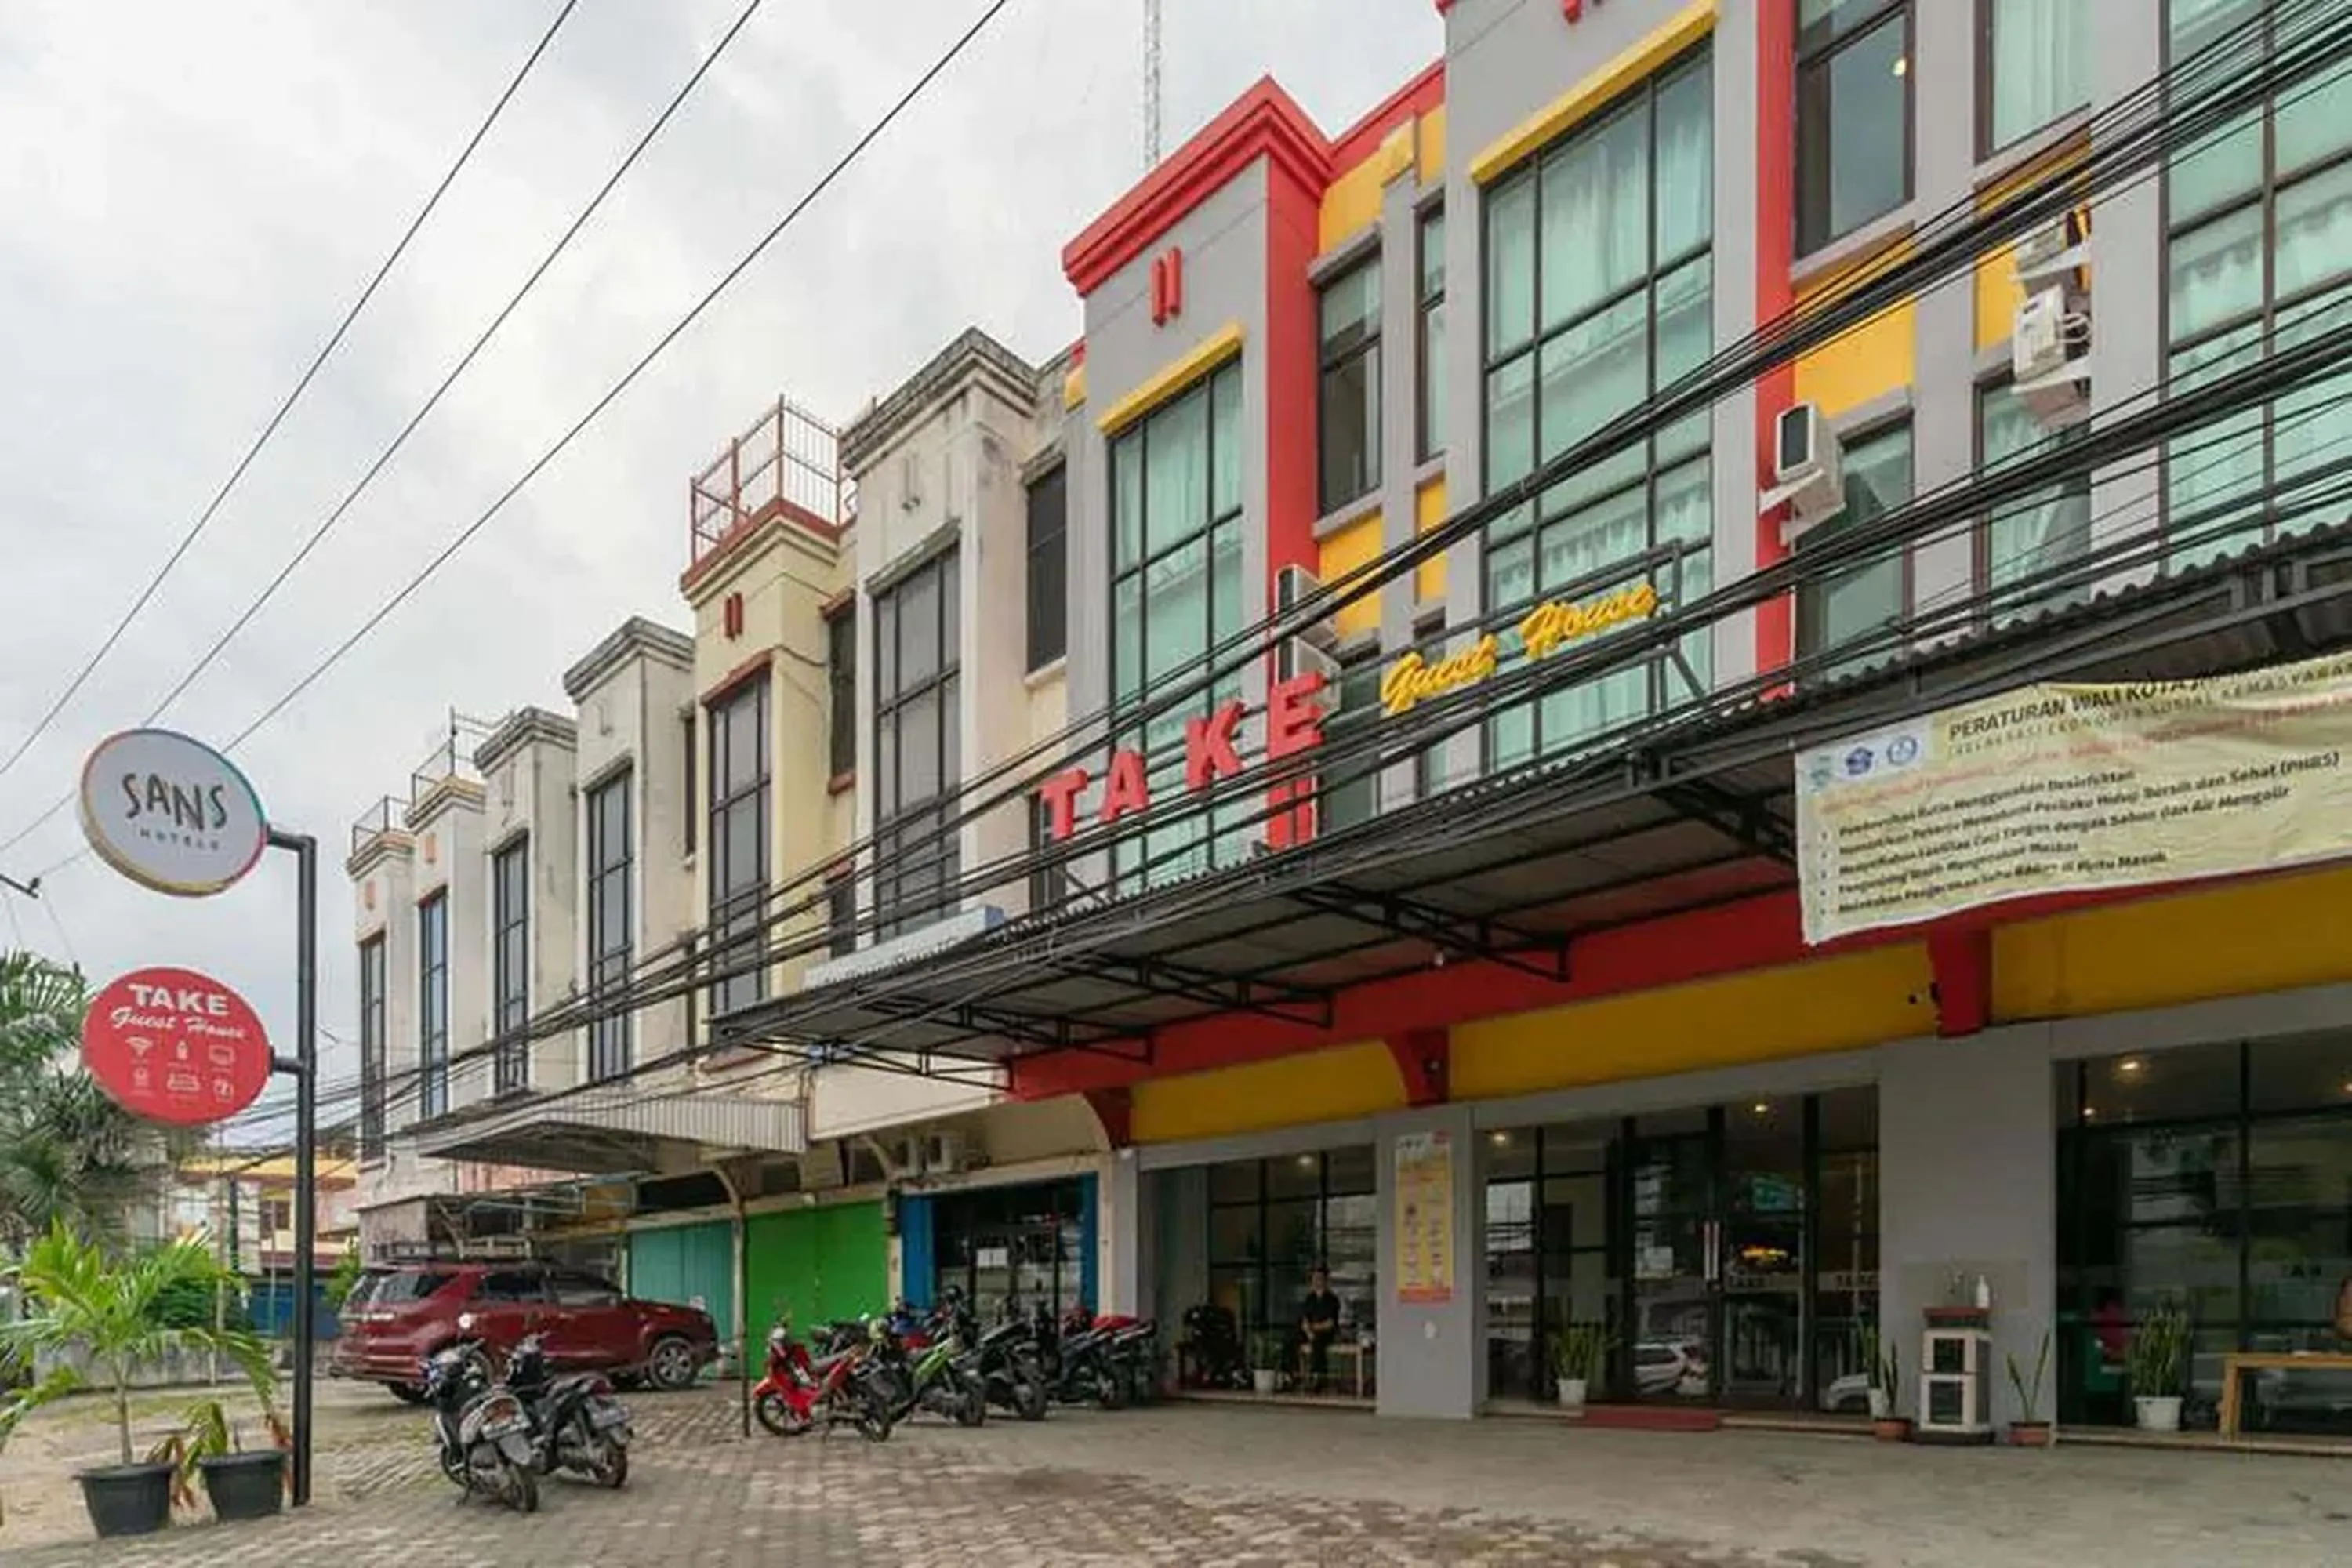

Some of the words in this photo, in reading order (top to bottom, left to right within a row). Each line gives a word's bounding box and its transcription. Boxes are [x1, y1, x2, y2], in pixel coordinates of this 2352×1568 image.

[1381, 632, 1499, 713] Guest
[1519, 582, 1658, 660] House
[1949, 698, 2067, 742] PERATURAN
[2071, 688, 2122, 713] WALI
[1040, 670, 1327, 841] TAKE
[2229, 763, 2277, 783] Sehat
[122, 772, 228, 832] SANS
[110, 1006, 177, 1029] Guest
[183, 1015, 245, 1040] House
[127, 982, 230, 1017] TAKE
